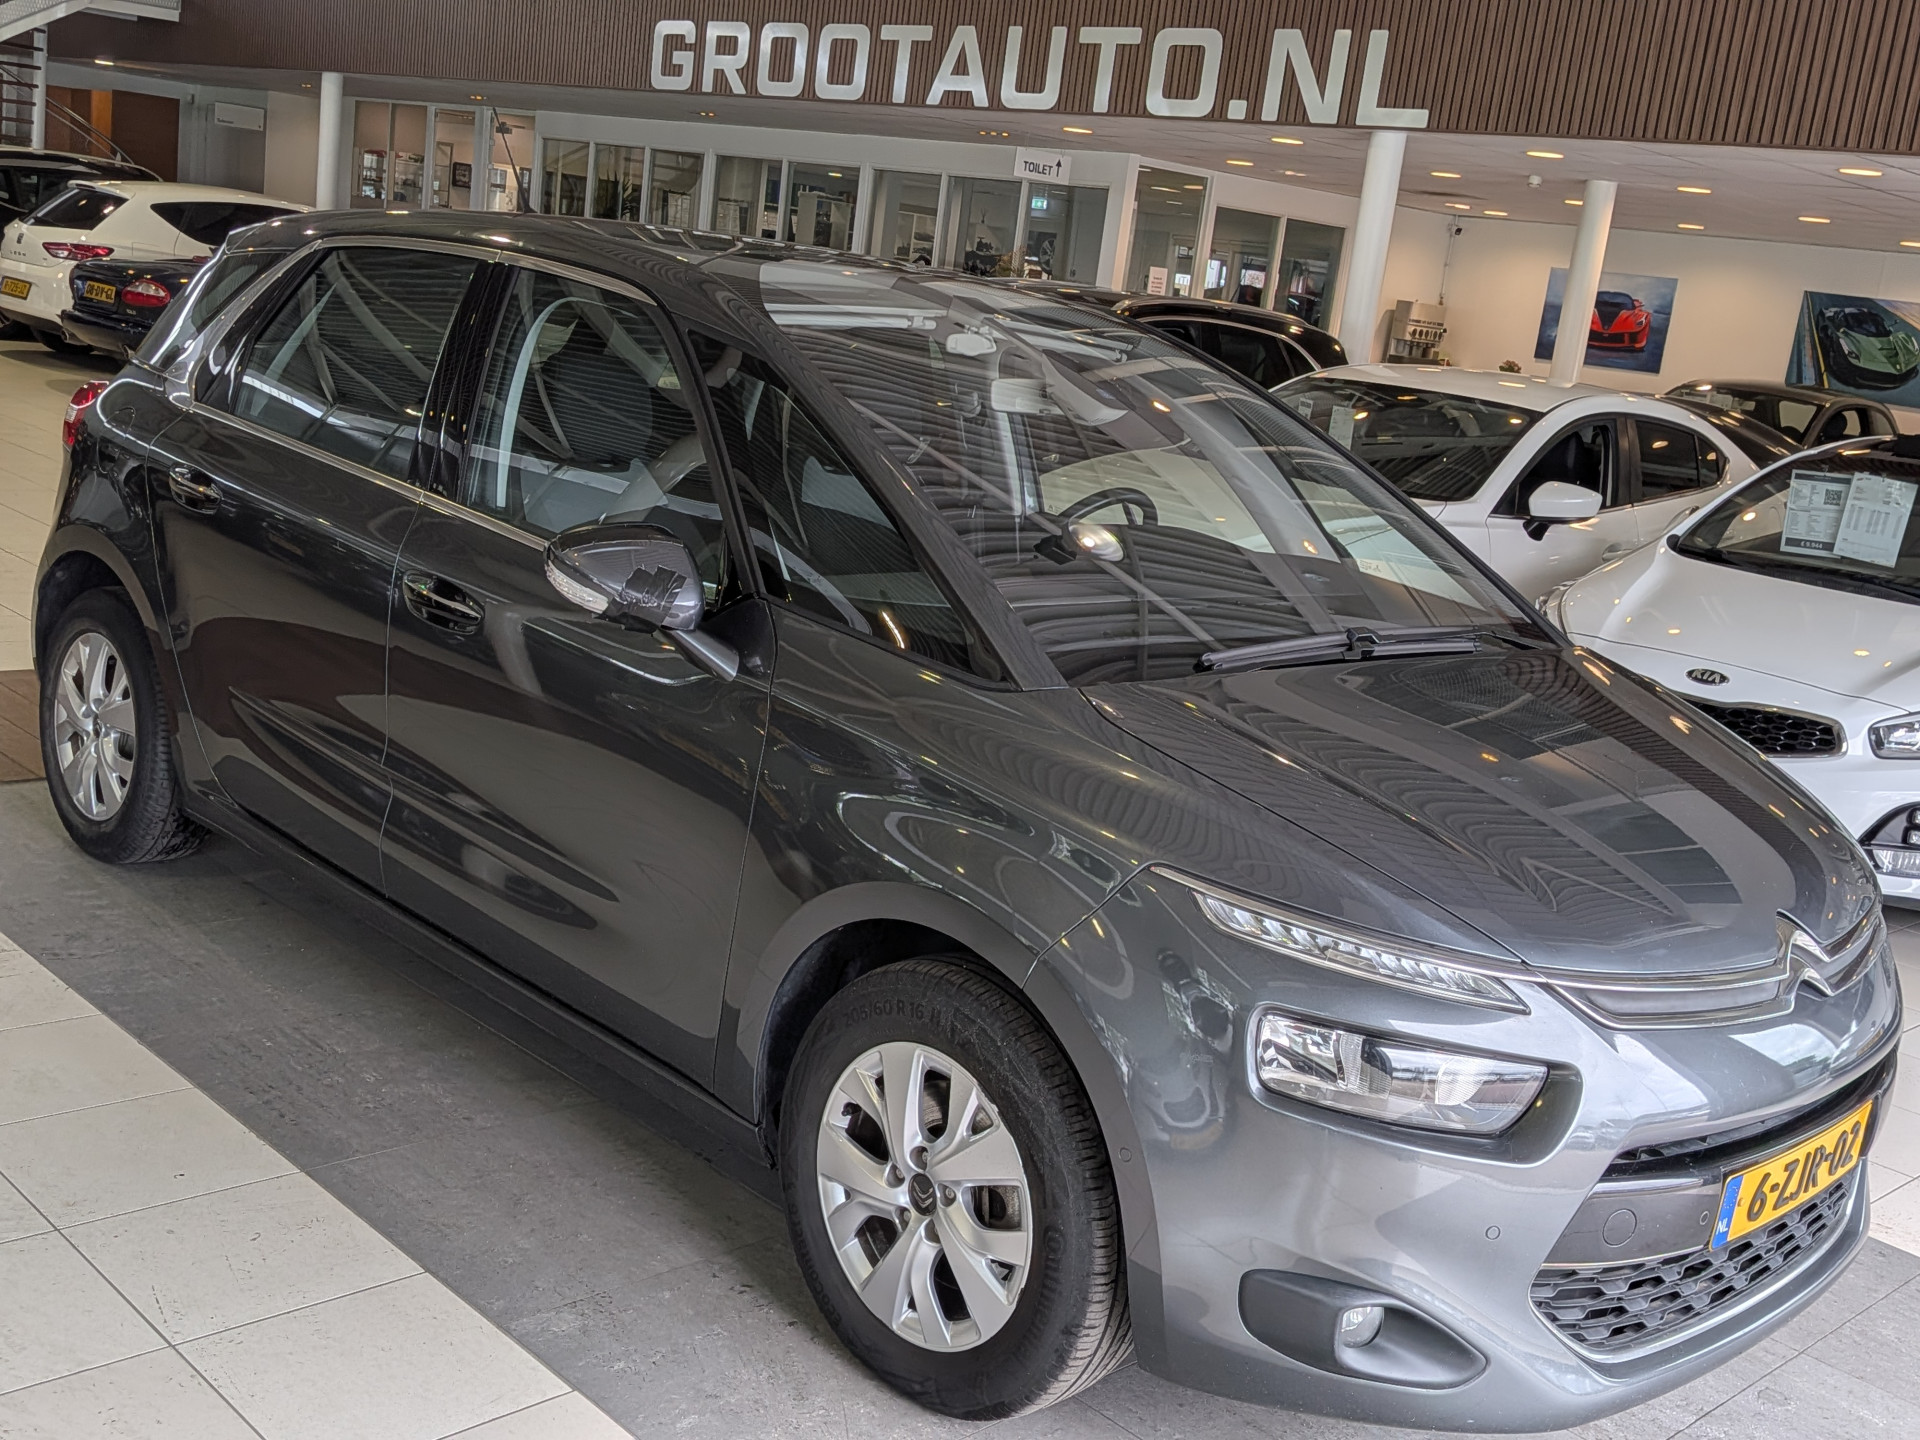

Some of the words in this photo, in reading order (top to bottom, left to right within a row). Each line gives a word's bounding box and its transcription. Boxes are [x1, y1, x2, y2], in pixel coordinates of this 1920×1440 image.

[651, 19, 1430, 129] GROOTAUTO.NL
[1023, 160, 1053, 176] TOILET
[1691, 669, 1721, 683] KIA
[909, 1002, 925, 1020] 16
[1747, 1120, 1861, 1222] 6-ZJR-02
[1716, 1217, 1729, 1236] NL
